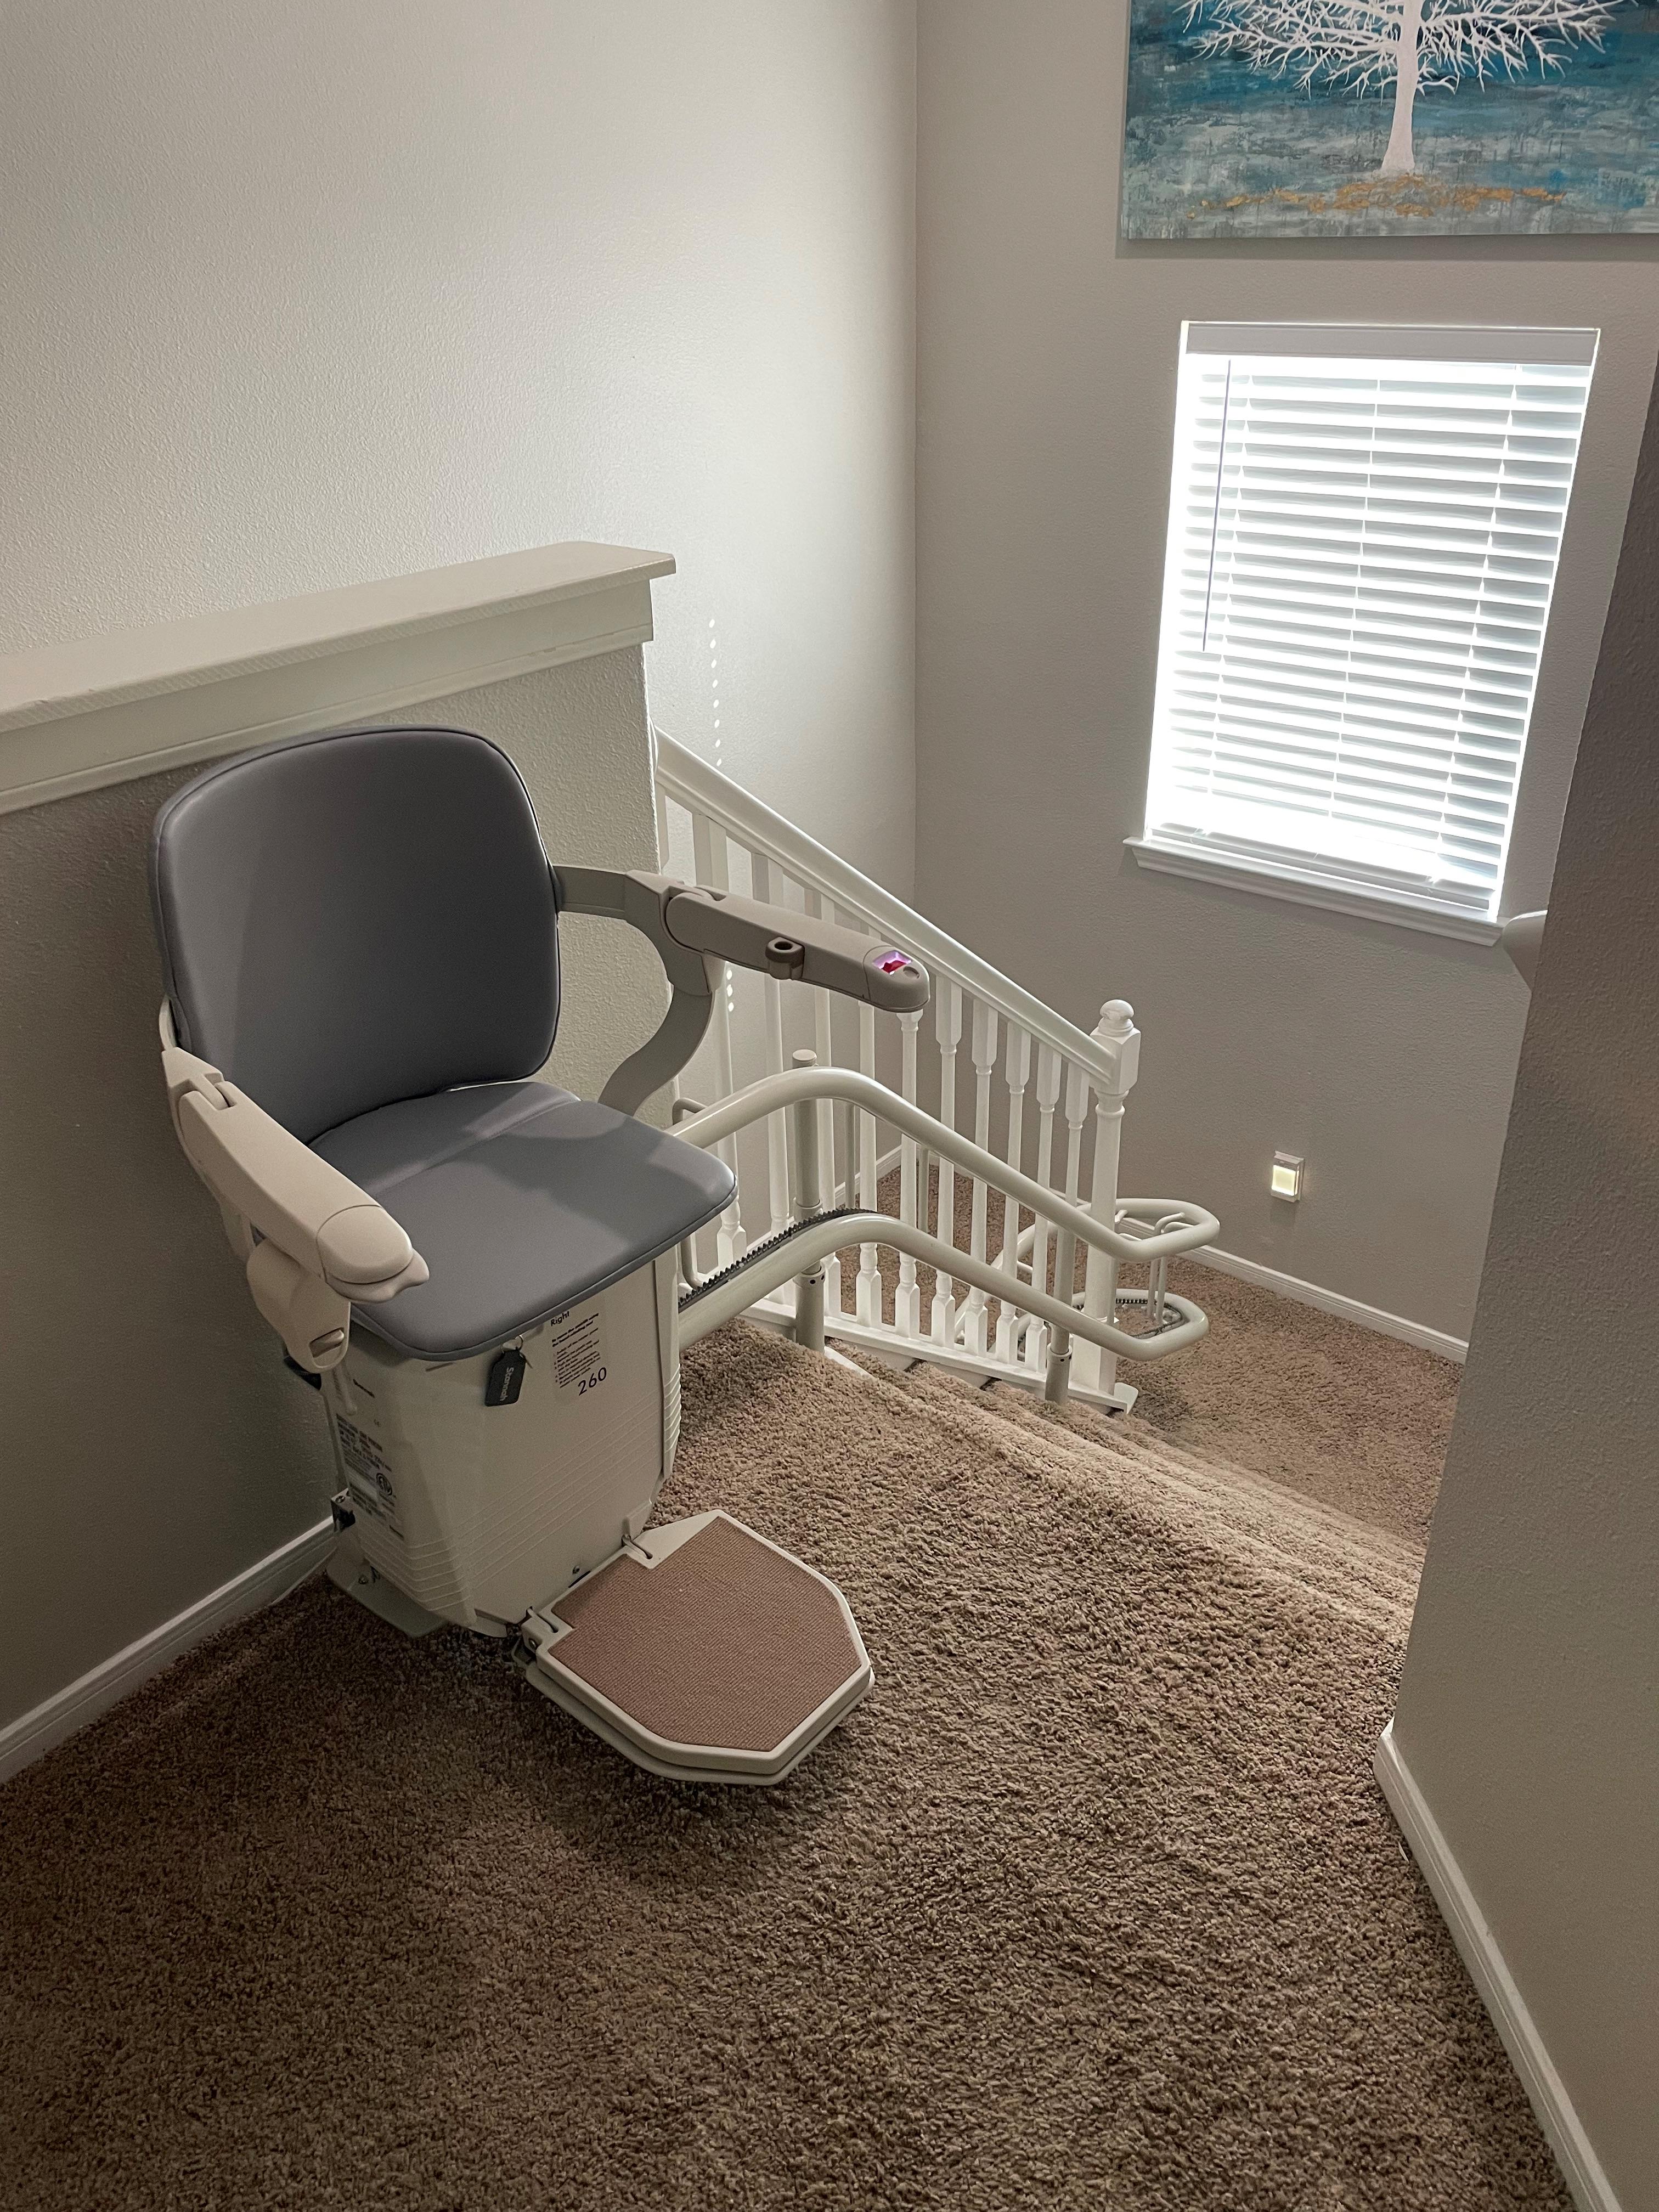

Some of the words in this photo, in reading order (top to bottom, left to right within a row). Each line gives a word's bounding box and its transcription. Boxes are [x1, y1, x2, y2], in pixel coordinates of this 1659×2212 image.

[551, 1311, 570, 1327] Right
[500, 1367, 515, 1401] Stannah
[578, 1367, 607, 1396] 260
